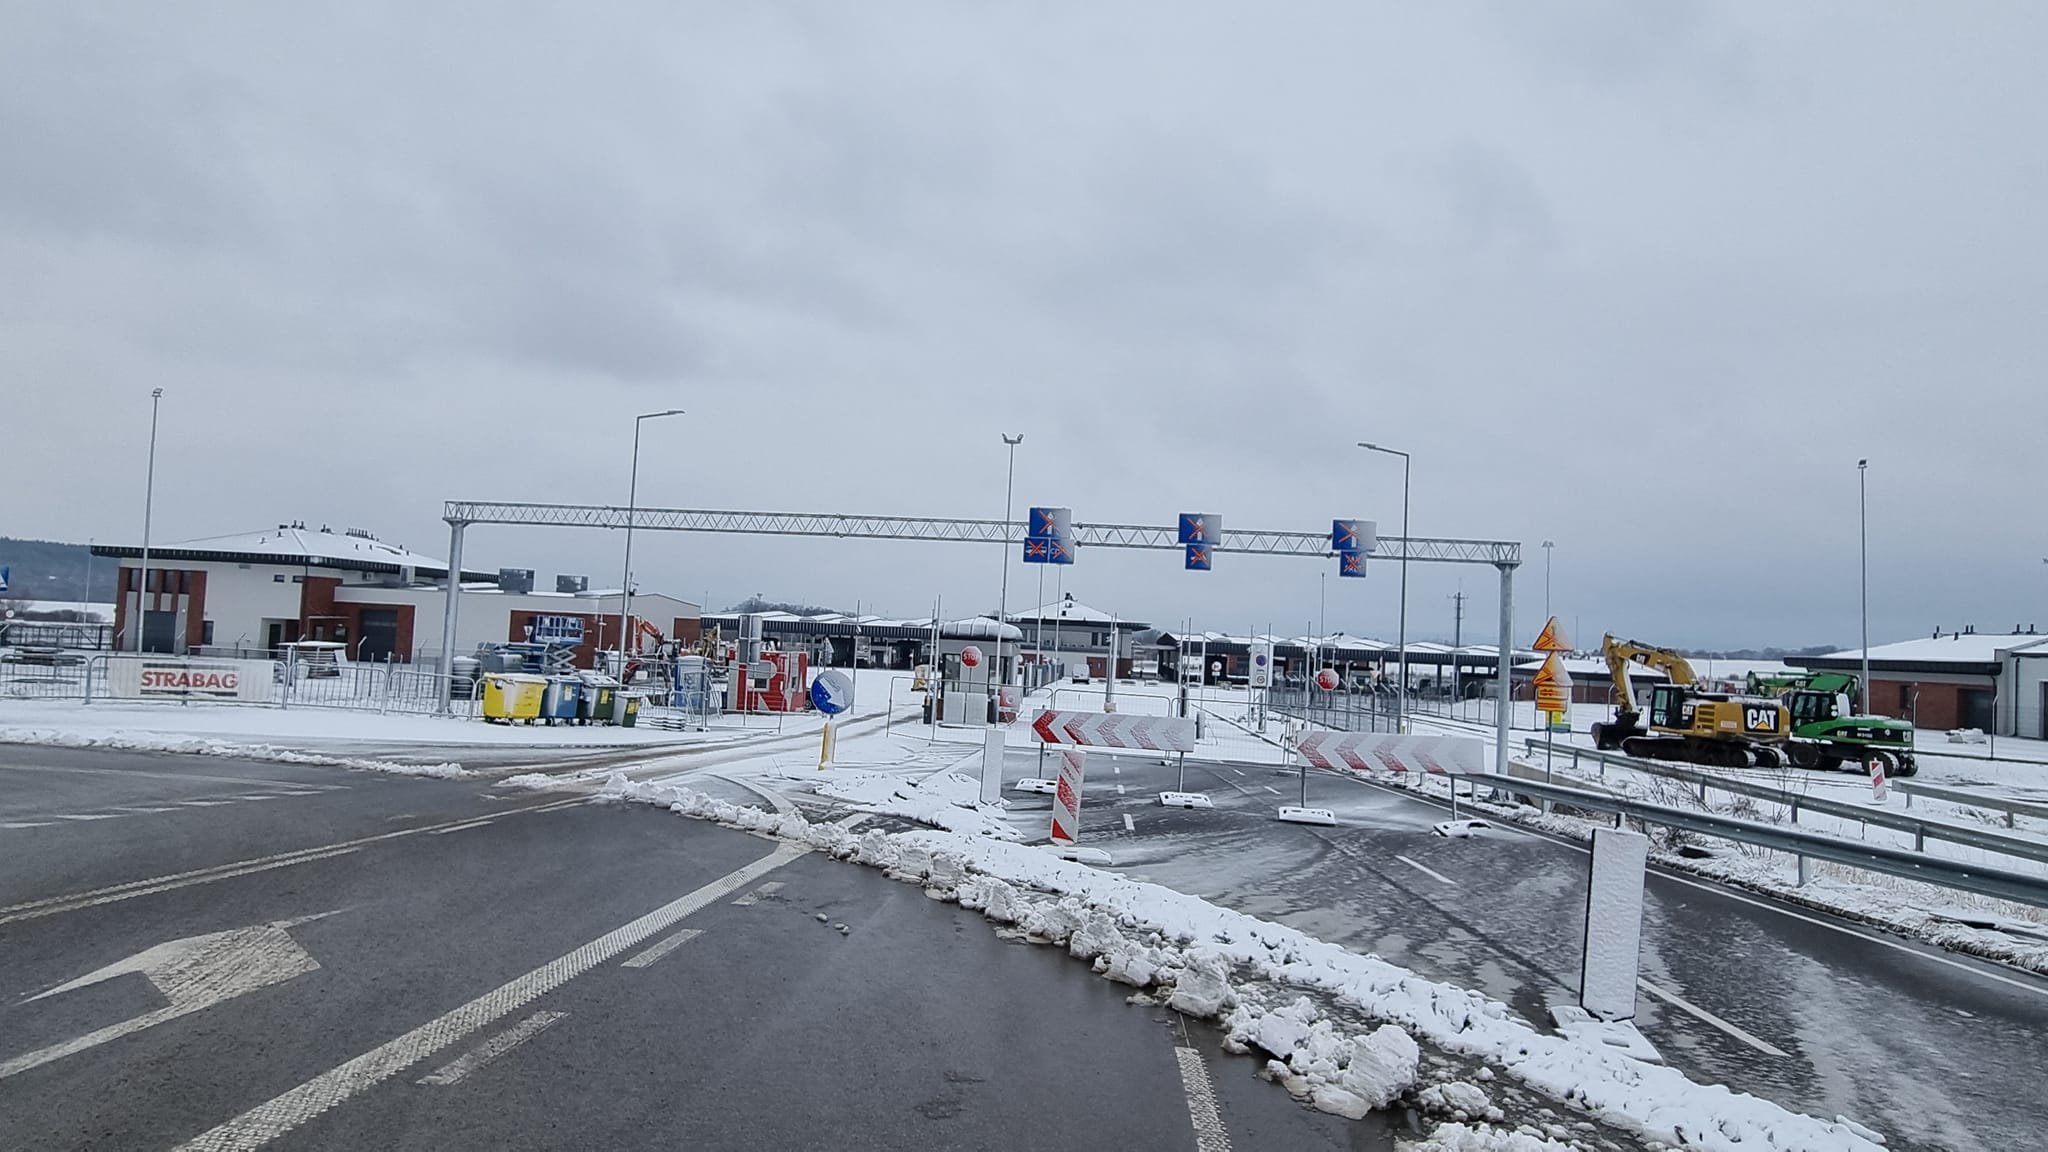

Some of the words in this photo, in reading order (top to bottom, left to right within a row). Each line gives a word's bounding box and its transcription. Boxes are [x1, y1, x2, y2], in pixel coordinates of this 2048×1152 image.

[141, 671, 238, 689] STRABAG
[1682, 705, 1694, 715] CAT
[1747, 708, 1776, 730] CAT
